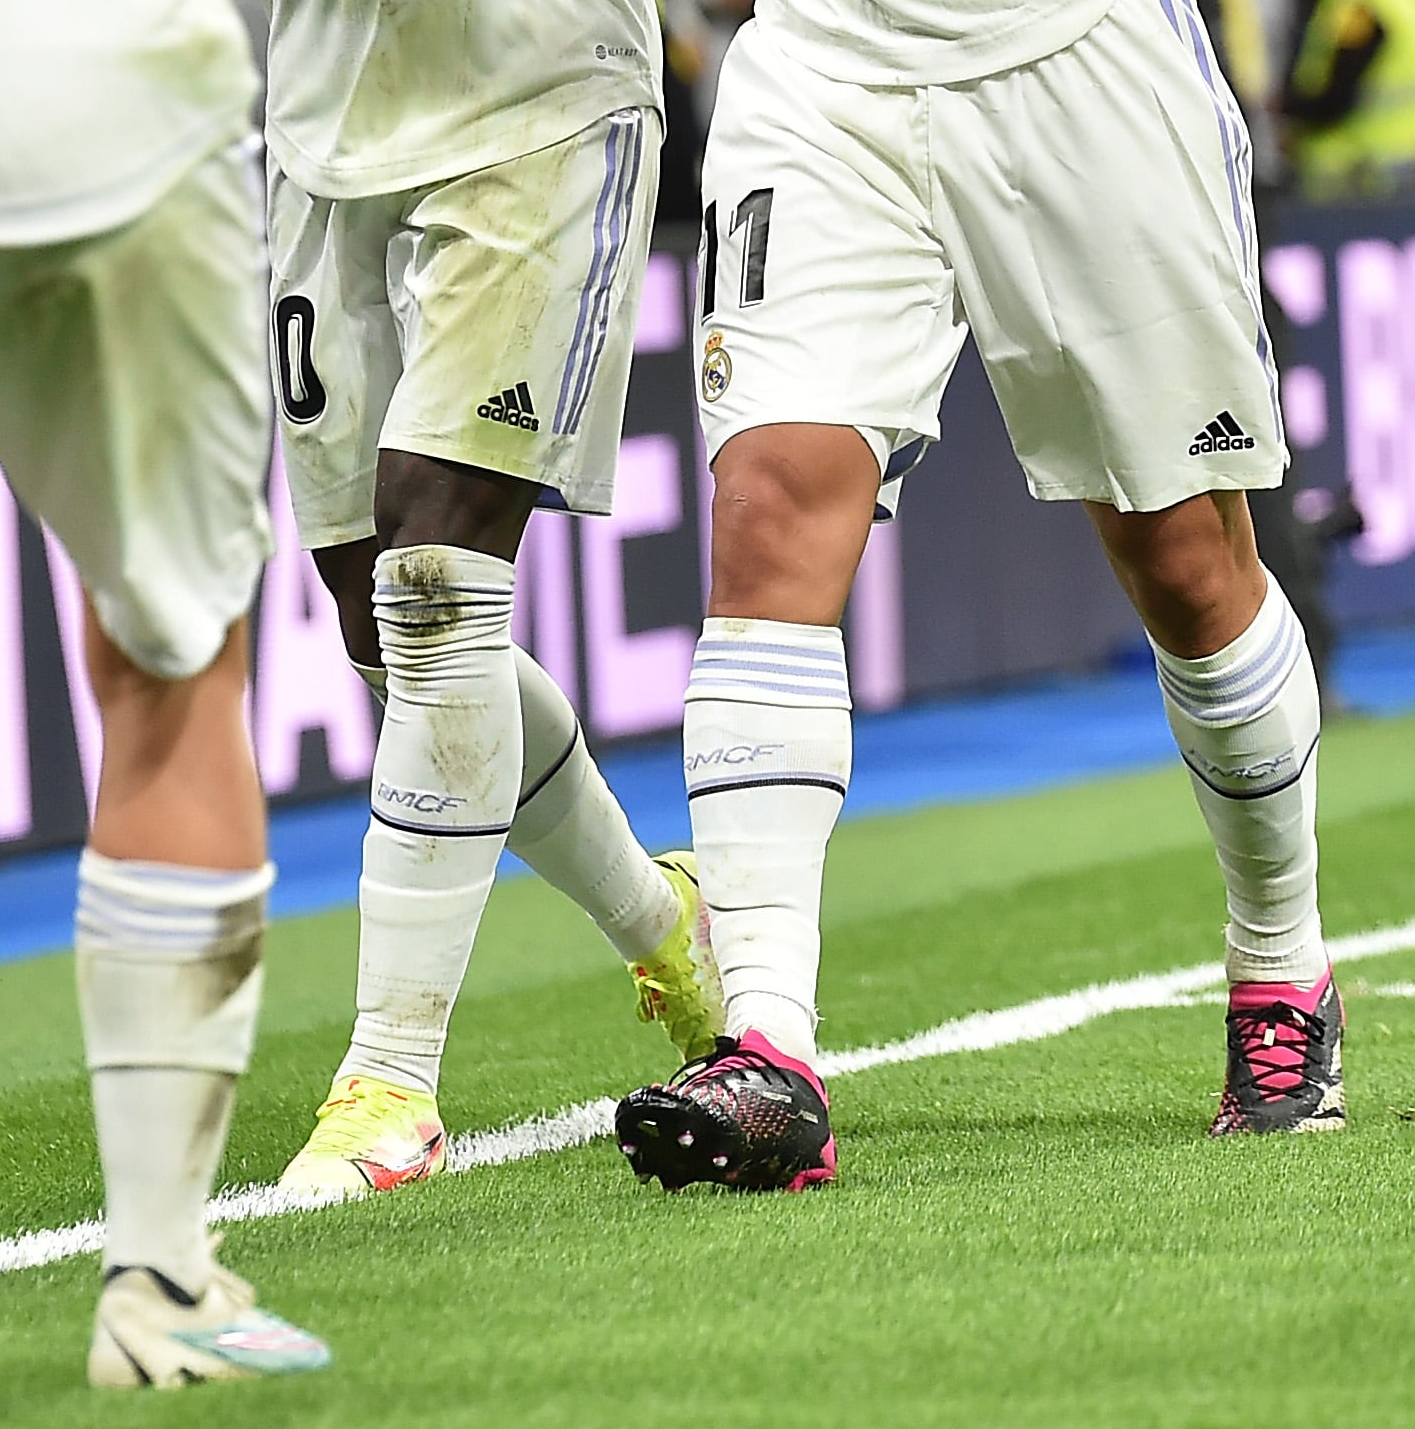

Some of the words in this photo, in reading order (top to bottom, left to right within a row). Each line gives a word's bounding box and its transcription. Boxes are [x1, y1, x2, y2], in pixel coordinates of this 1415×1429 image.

[700, 187, 774, 326] 11
[476, 403, 540, 432] adidas
[1188, 433, 1255, 456] adidas
